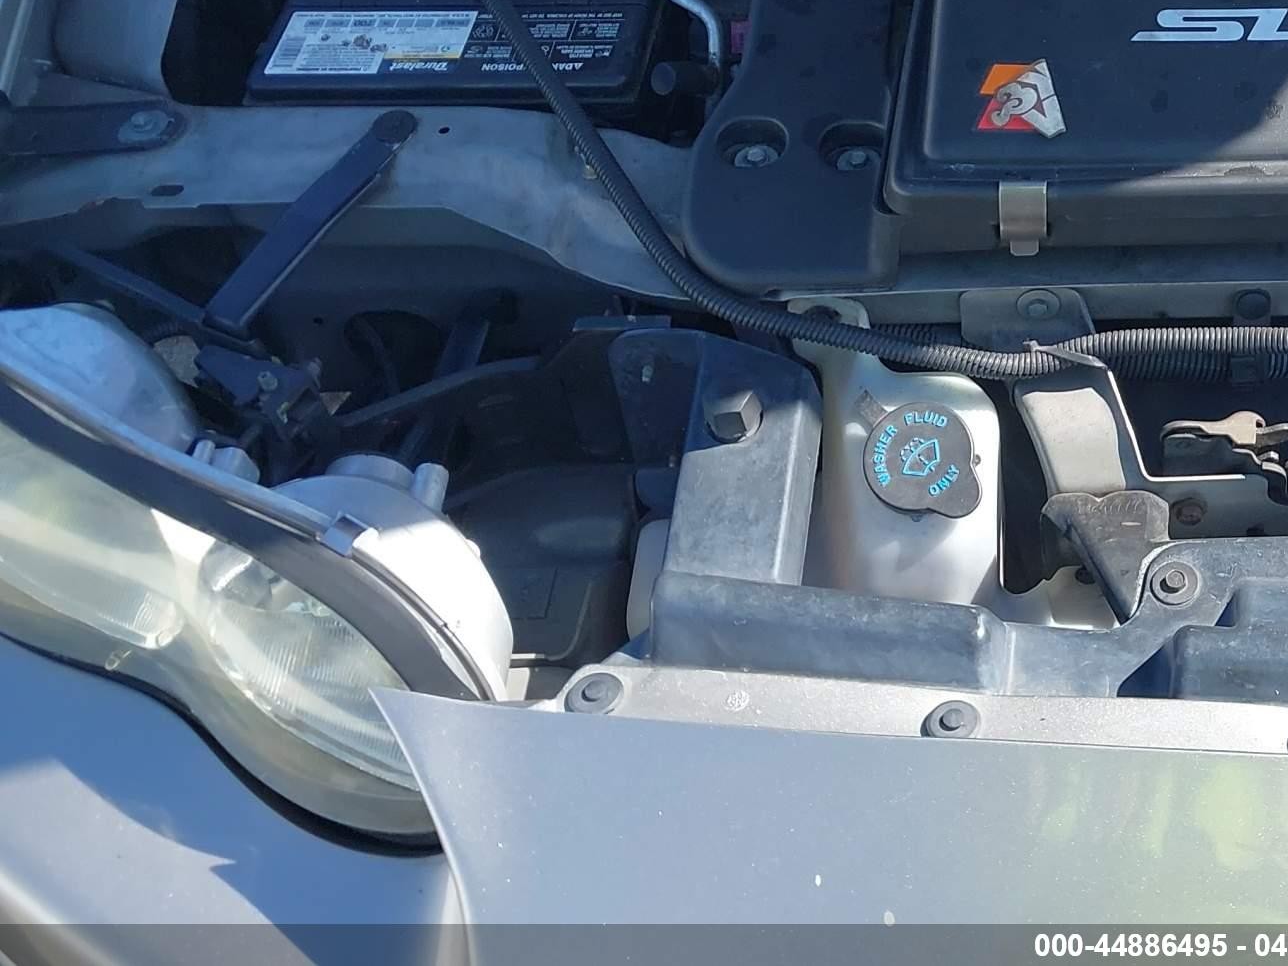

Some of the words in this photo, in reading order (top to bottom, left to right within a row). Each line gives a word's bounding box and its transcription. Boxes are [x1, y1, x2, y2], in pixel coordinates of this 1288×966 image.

[389, 60, 449, 72] Duralast
[480, 62, 524, 72] POISON
[872, 425, 898, 487] WASHER
[904, 410, 948, 428] FLUID
[928, 464, 960, 497] ONLY
